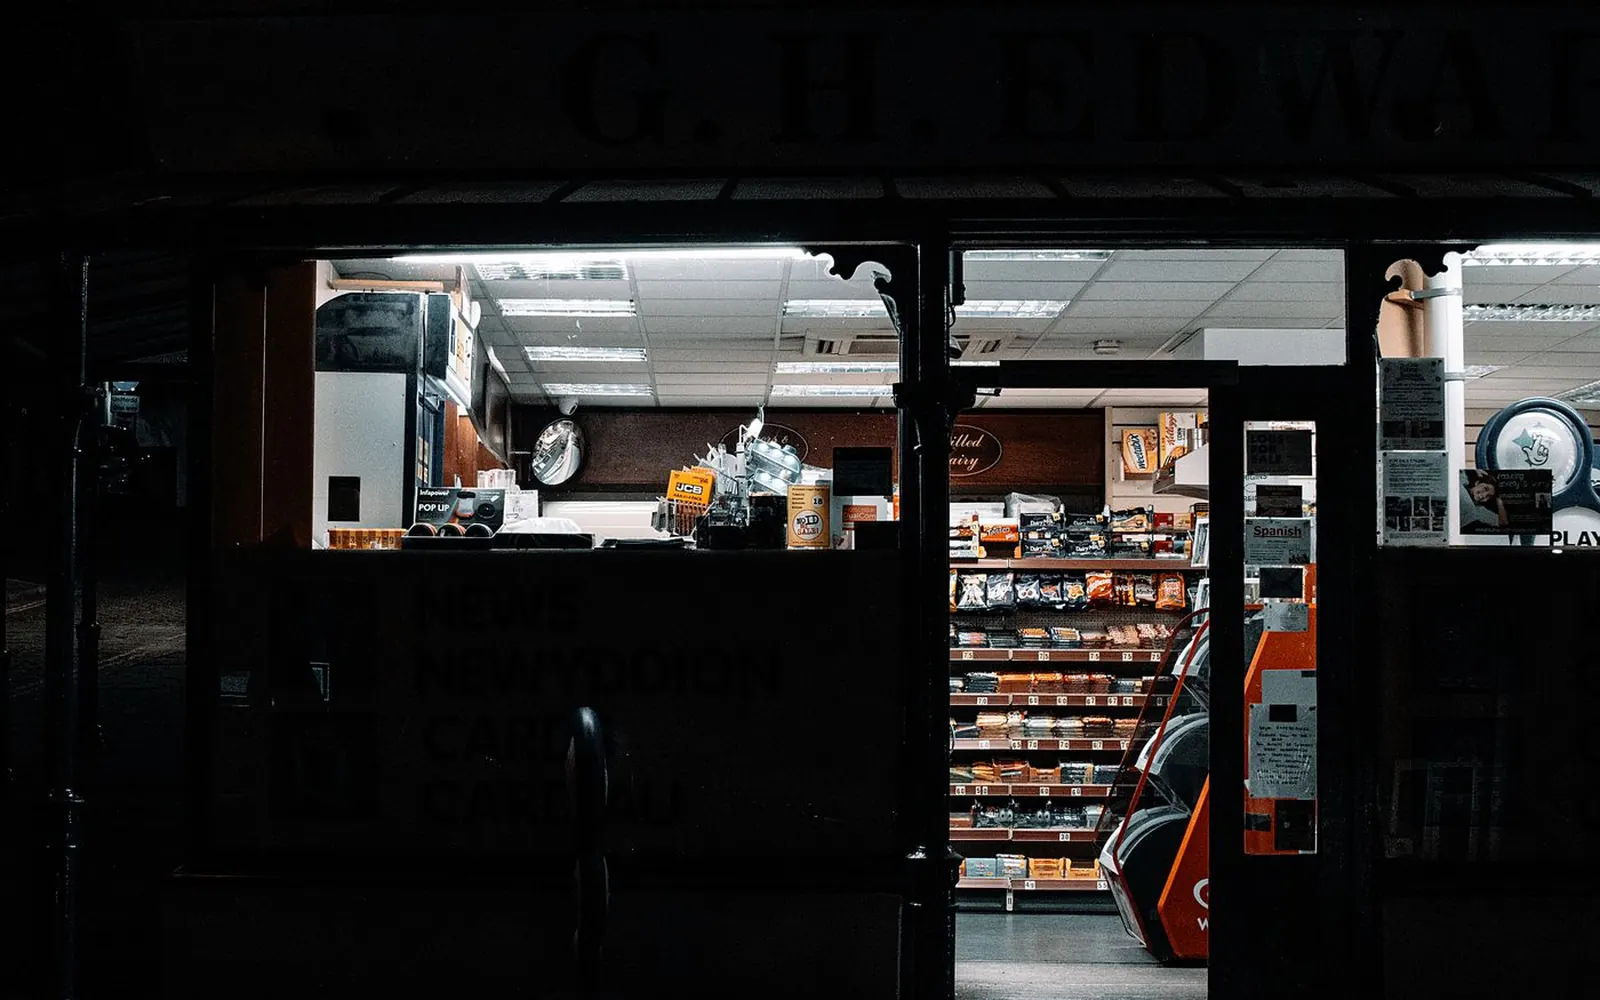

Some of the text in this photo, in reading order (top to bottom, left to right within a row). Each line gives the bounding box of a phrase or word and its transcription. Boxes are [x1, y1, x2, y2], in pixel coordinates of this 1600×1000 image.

[950, 434, 985, 448] illed
[949, 454, 979, 472] airy
[676, 482, 703, 495] JCB
[418, 503, 450, 512] POP UP
[813, 497, 823, 505] 18
[1253, 525, 1302, 537] Spanish
[422, 715, 606, 762] CARD
[422, 779, 683, 826] CARDAU
